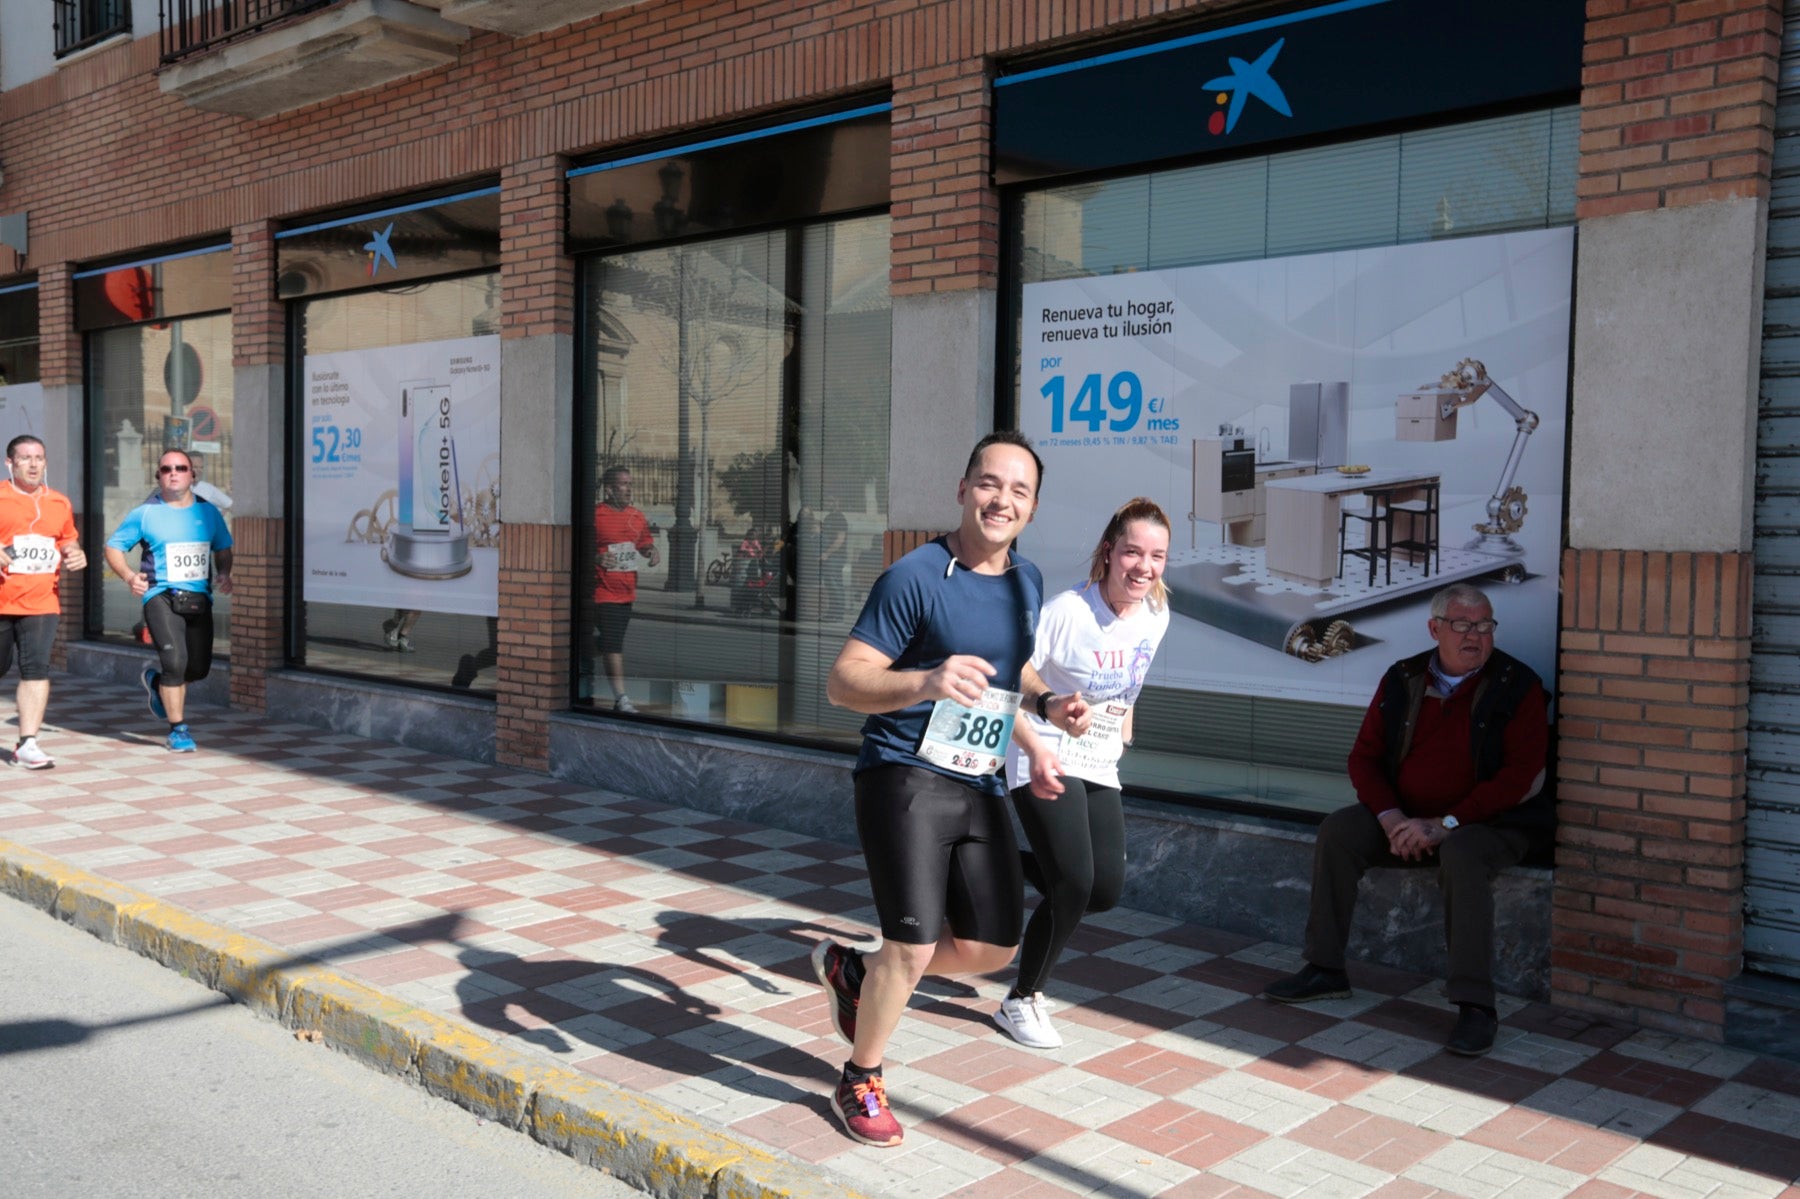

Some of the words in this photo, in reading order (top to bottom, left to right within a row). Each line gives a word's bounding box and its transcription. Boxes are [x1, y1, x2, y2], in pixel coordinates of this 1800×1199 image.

[1042, 307, 1103, 323] Renueva
[1107, 304, 1122, 318] tu
[1127, 300, 1175, 319] hogar,
[1042, 327, 1098, 342] renueva
[1103, 324, 1118, 338] tu
[1123, 318, 1172, 337] ilusión
[1041, 357, 1062, 371] por
[312, 385, 321, 393] con
[1040, 371, 1142, 433] 149
[1148, 398, 1165, 413] €/
[439, 397, 450, 429] 5G
[1147, 418, 1179, 430] mes
[1049, 438, 1058, 446] 72
[1113, 437, 1125, 445] TIN
[439, 436, 450, 525] Note10+
[20, 547, 55, 560] 3037
[174, 553, 207, 568] 3036
[1093, 650, 1124, 670] VII
[1091, 670, 1123, 680] Prueba
[1088, 680, 1122, 691] Fondo
